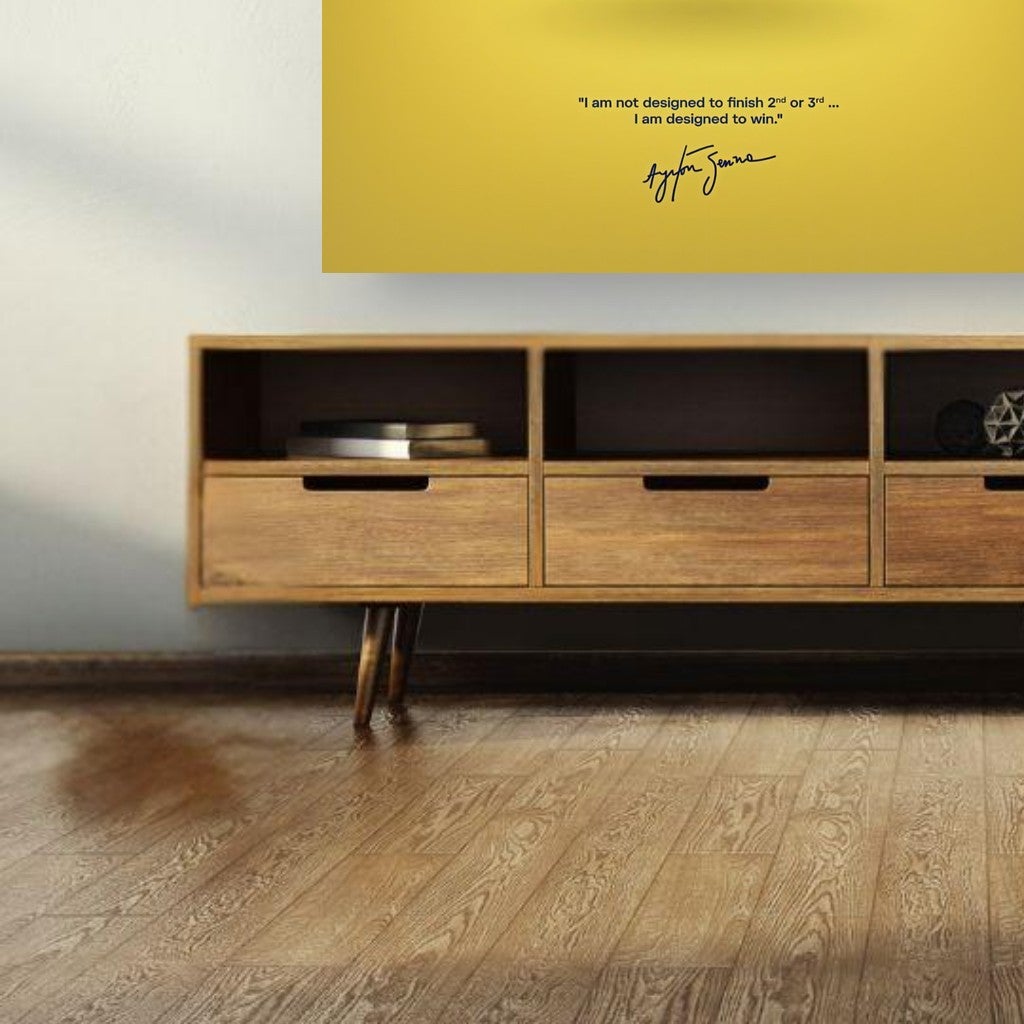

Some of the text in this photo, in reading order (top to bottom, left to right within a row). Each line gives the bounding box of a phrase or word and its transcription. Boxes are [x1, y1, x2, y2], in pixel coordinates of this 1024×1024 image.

[578, 96, 588, 109] "I
[592, 99, 612, 109] am
[616, 97, 640, 109] not
[643, 96, 705, 112] designed
[709, 97, 724, 109] to
[727, 96, 764, 109] finish
[790, 99, 805, 109] or
[634, 113, 783, 128] I am designed to win."
[702, 150, 777, 196] Senna
